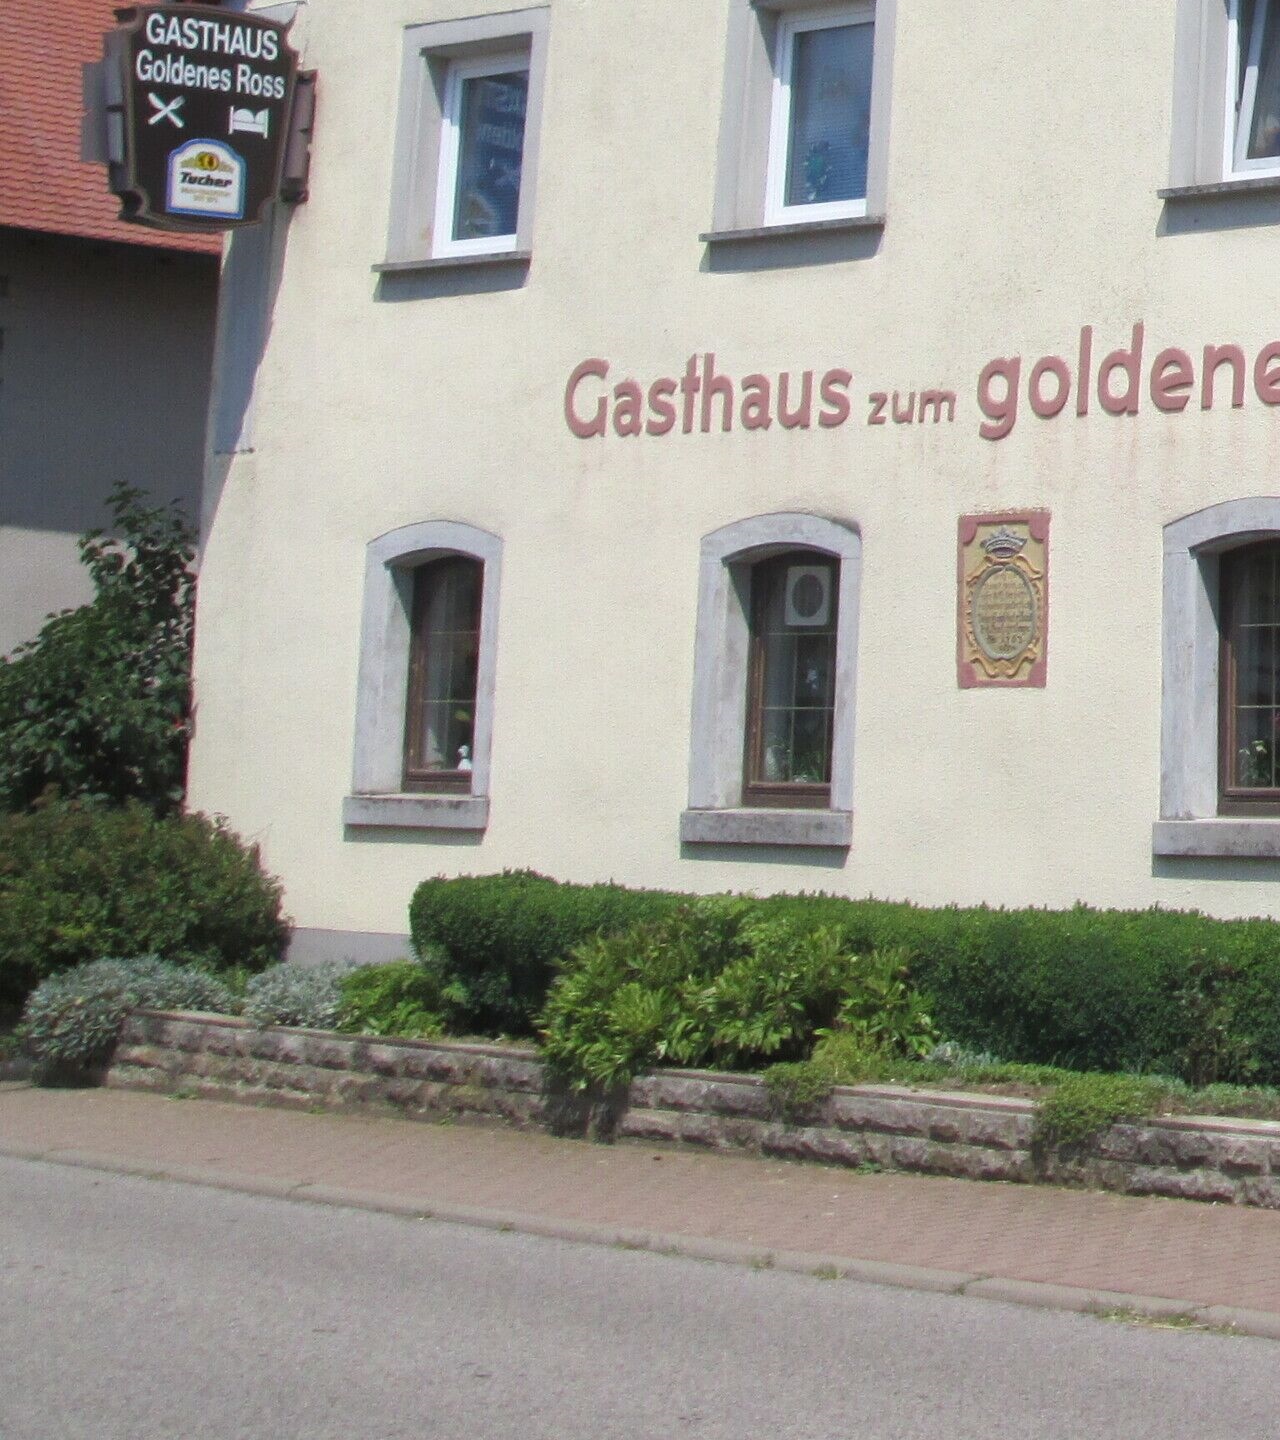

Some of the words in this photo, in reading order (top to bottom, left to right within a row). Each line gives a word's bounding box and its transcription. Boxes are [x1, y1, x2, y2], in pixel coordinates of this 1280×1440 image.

[146, 13, 279, 60] GASTHAUS
[136, 50, 231, 92] Goldenes
[236, 64, 285, 99] Ross
[180, 172, 232, 187] Tucher
[564, 353, 852, 439] Gasthaus
[867, 389, 957, 425] zum
